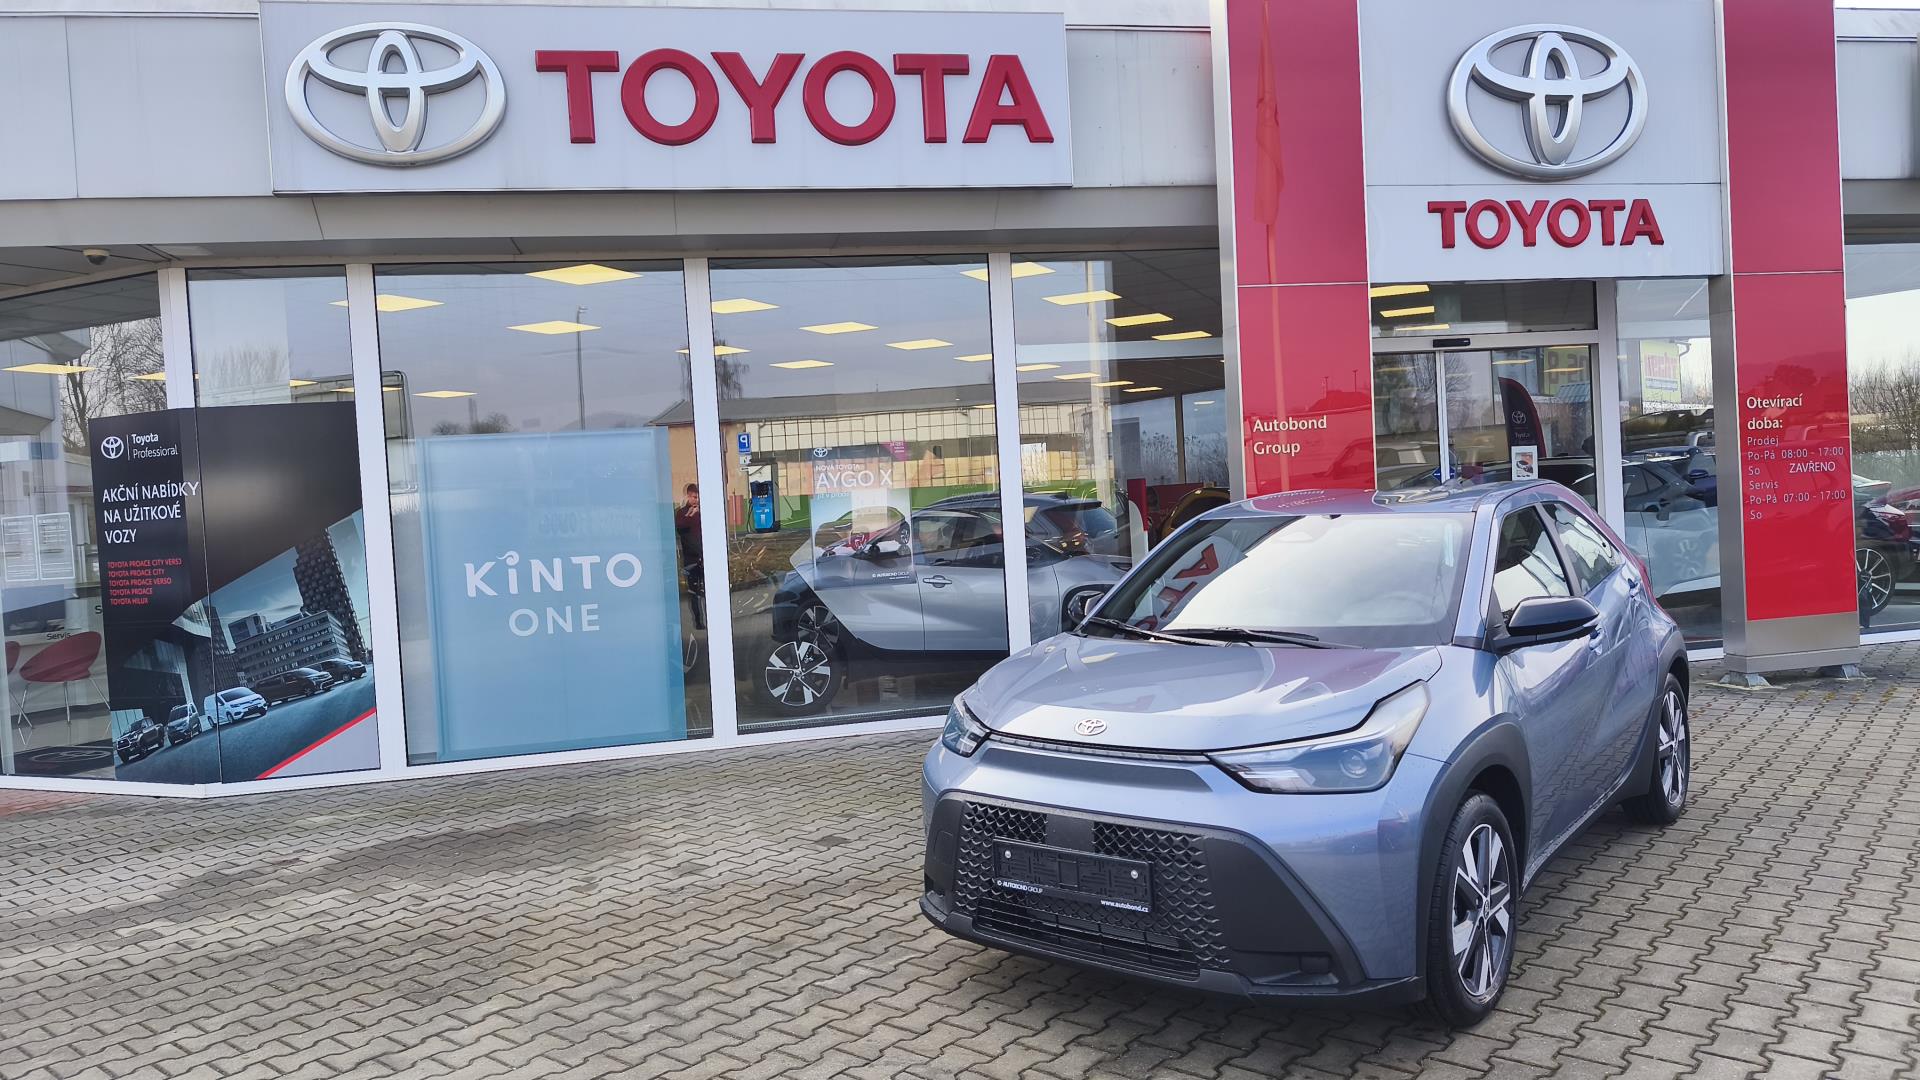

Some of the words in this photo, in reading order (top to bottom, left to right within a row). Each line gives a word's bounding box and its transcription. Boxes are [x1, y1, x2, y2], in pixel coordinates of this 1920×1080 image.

[535, 48, 1055, 146] TOYOTA
[1427, 198, 1664, 249] TOYOTA
[1746, 393, 1803, 409] Otevírací
[1253, 415, 1327, 432] Autobond
[1747, 417, 1783, 430] doba:
[131, 433, 159, 446] Toyota
[1747, 437, 1779, 447] Prodej
[133, 443, 178, 459] Professional
[1253, 442, 1300, 456] Group
[1748, 450, 1775, 461] Po-Pá
[1782, 449, 1808, 459] 08:00
[1818, 447, 1844, 457] 17:00
[1748, 466, 1760, 476] So
[1789, 461, 1836, 474] ZAVŘENO
[816, 470, 875, 489] AYGO
[879, 469, 892, 486] X
[1749, 481, 1779, 490] Servis
[102, 483, 139, 503] AKČNÍ
[142, 480, 200, 500] NABÍDKY
[1750, 495, 1777, 505] Po-Pá
[1783, 492, 1810, 503] 07:00
[1820, 490, 1846, 500] 17:00
[104, 509, 122, 524] NA
[124, 501, 181, 522] UŽITKOVÉ
[1750, 510, 1762, 520] So
[105, 529, 137, 544] VOZY
[508, 603, 600, 637] ONE
[46, 632, 71, 640] Servis
[1003, 881, 1027, 891] AUTOBOND
[1101, 899, 1149, 913] www.autobond.cz
